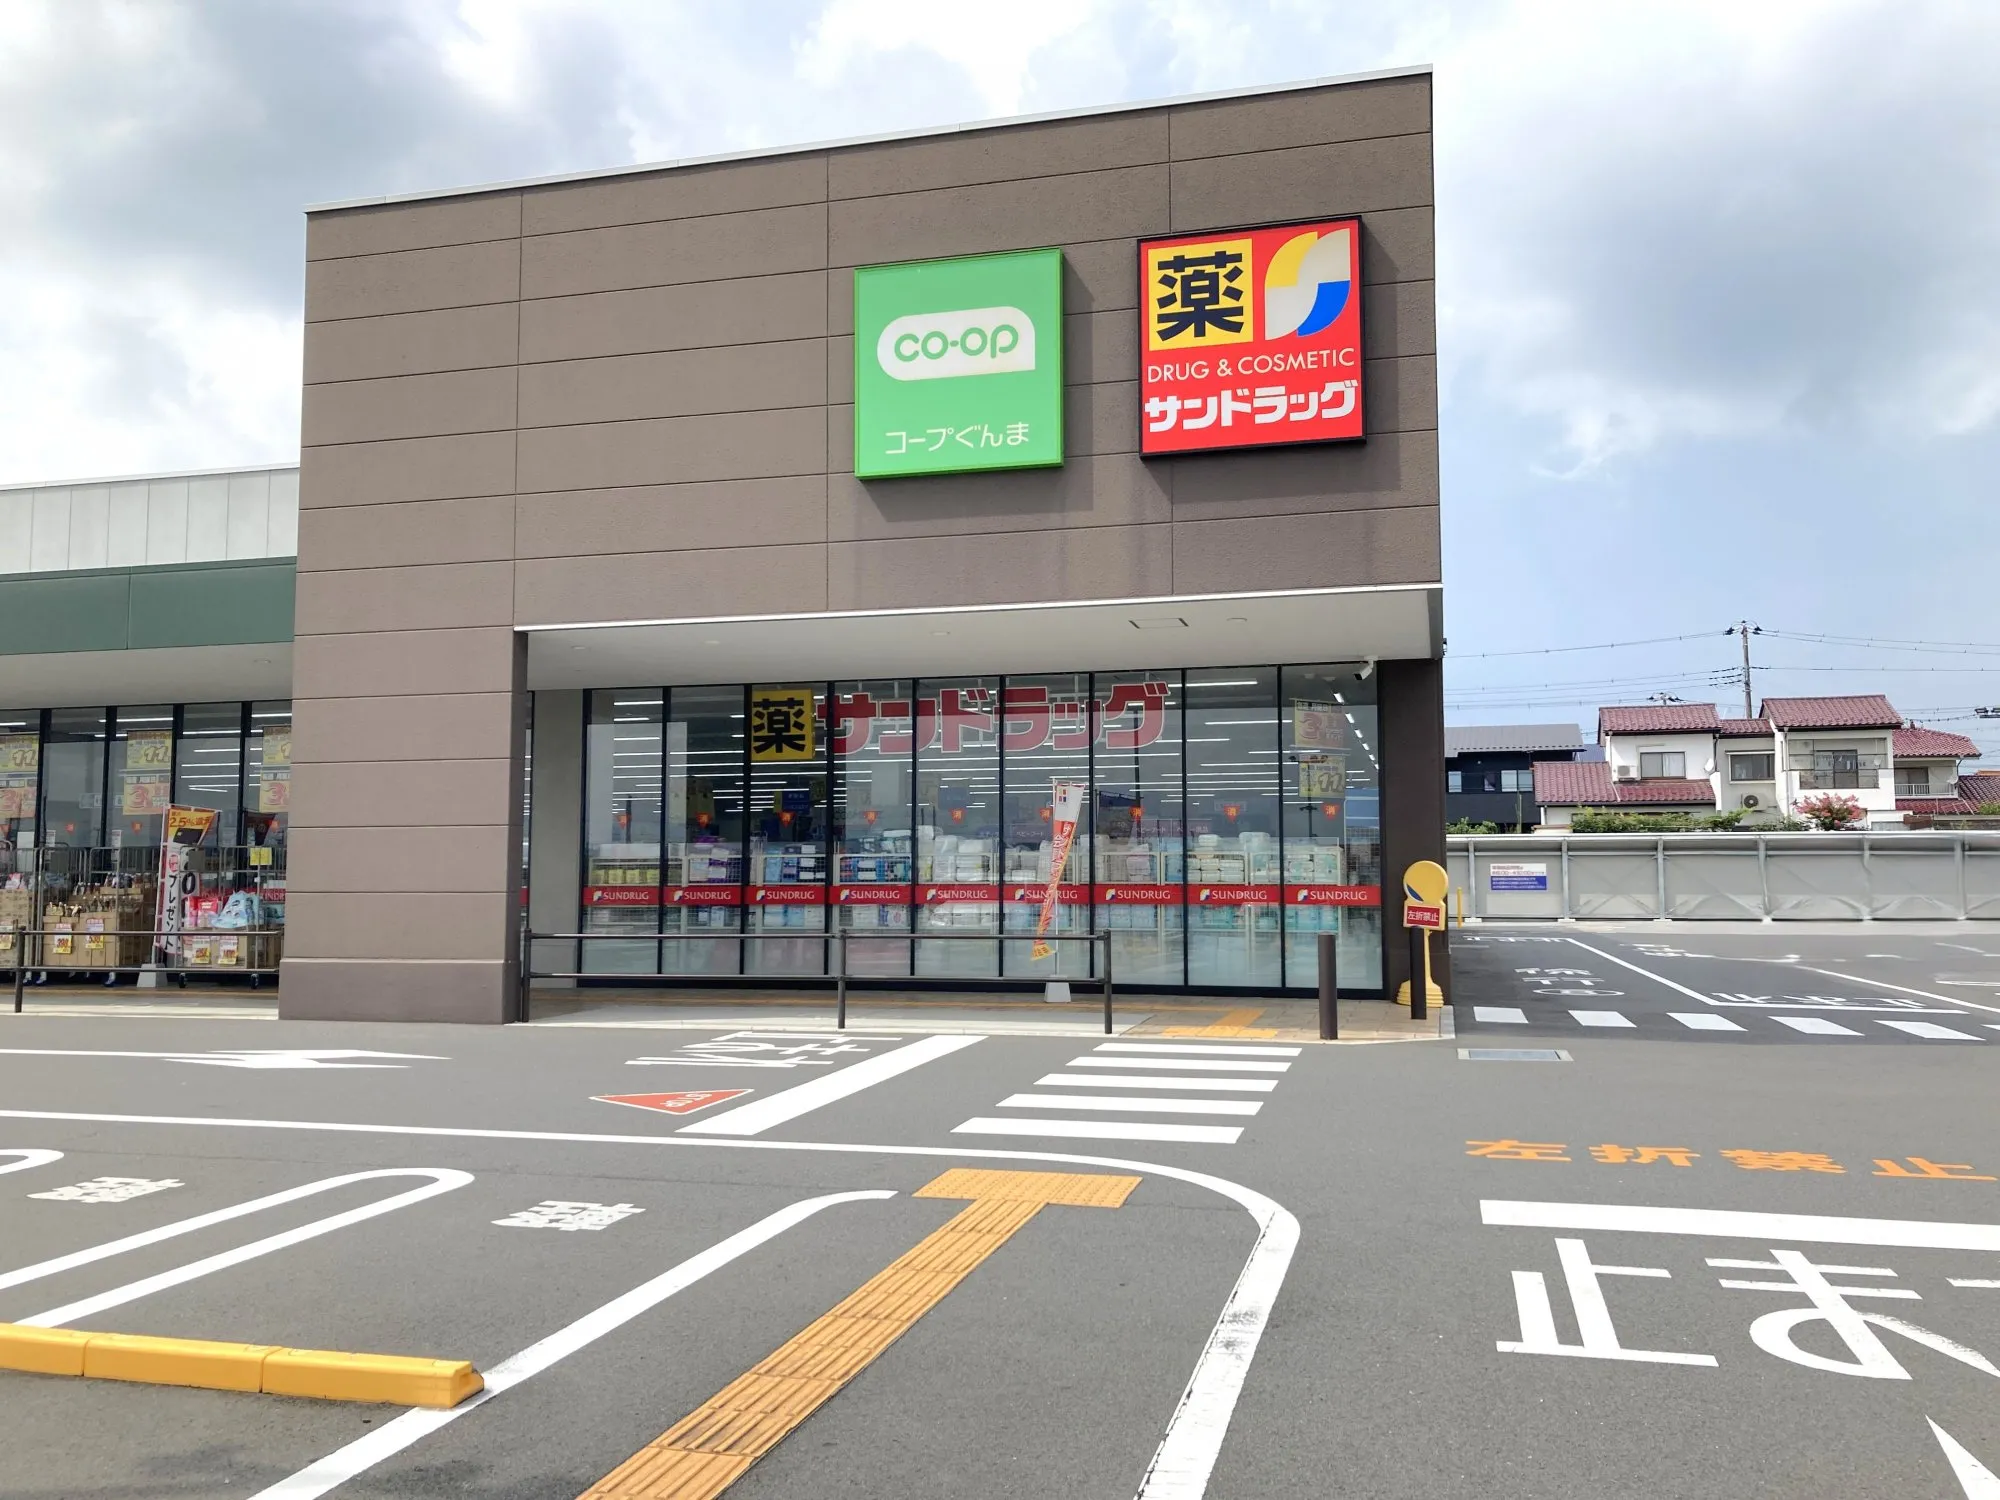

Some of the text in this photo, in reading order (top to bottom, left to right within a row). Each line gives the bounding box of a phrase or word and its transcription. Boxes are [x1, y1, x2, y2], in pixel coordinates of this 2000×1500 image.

[1156, 250, 1244, 341] 薬
[1148, 348, 1355, 383] DRUG & COSMETIC
[1145, 380, 1358, 433] サンドラッグ
[885, 421, 1030, 455] コープぐんま
[752, 697, 806, 754] 薬
[816, 682, 1169, 755] サンドラッグ
[602, 891, 649, 900] SUNDRUG
[683, 891, 731, 900] SUNDRUG
[766, 890, 815, 900] SUNDRUG
[851, 890, 900, 899] SUNDRUG
[937, 889, 988, 899] SUNDRUG
[1117, 889, 1171, 899] SUNDRUG
[1212, 889, 1268, 900] SUNDRUG
[1310, 889, 1368, 900] SUNDRUG
[164, 873, 178, 951] プレゼント
[1407, 910, 1439, 922] 左折禁止
[1465, 1139, 1998, 1182] 左折禁止
[1496, 1237, 2000, 1380] 止ま
